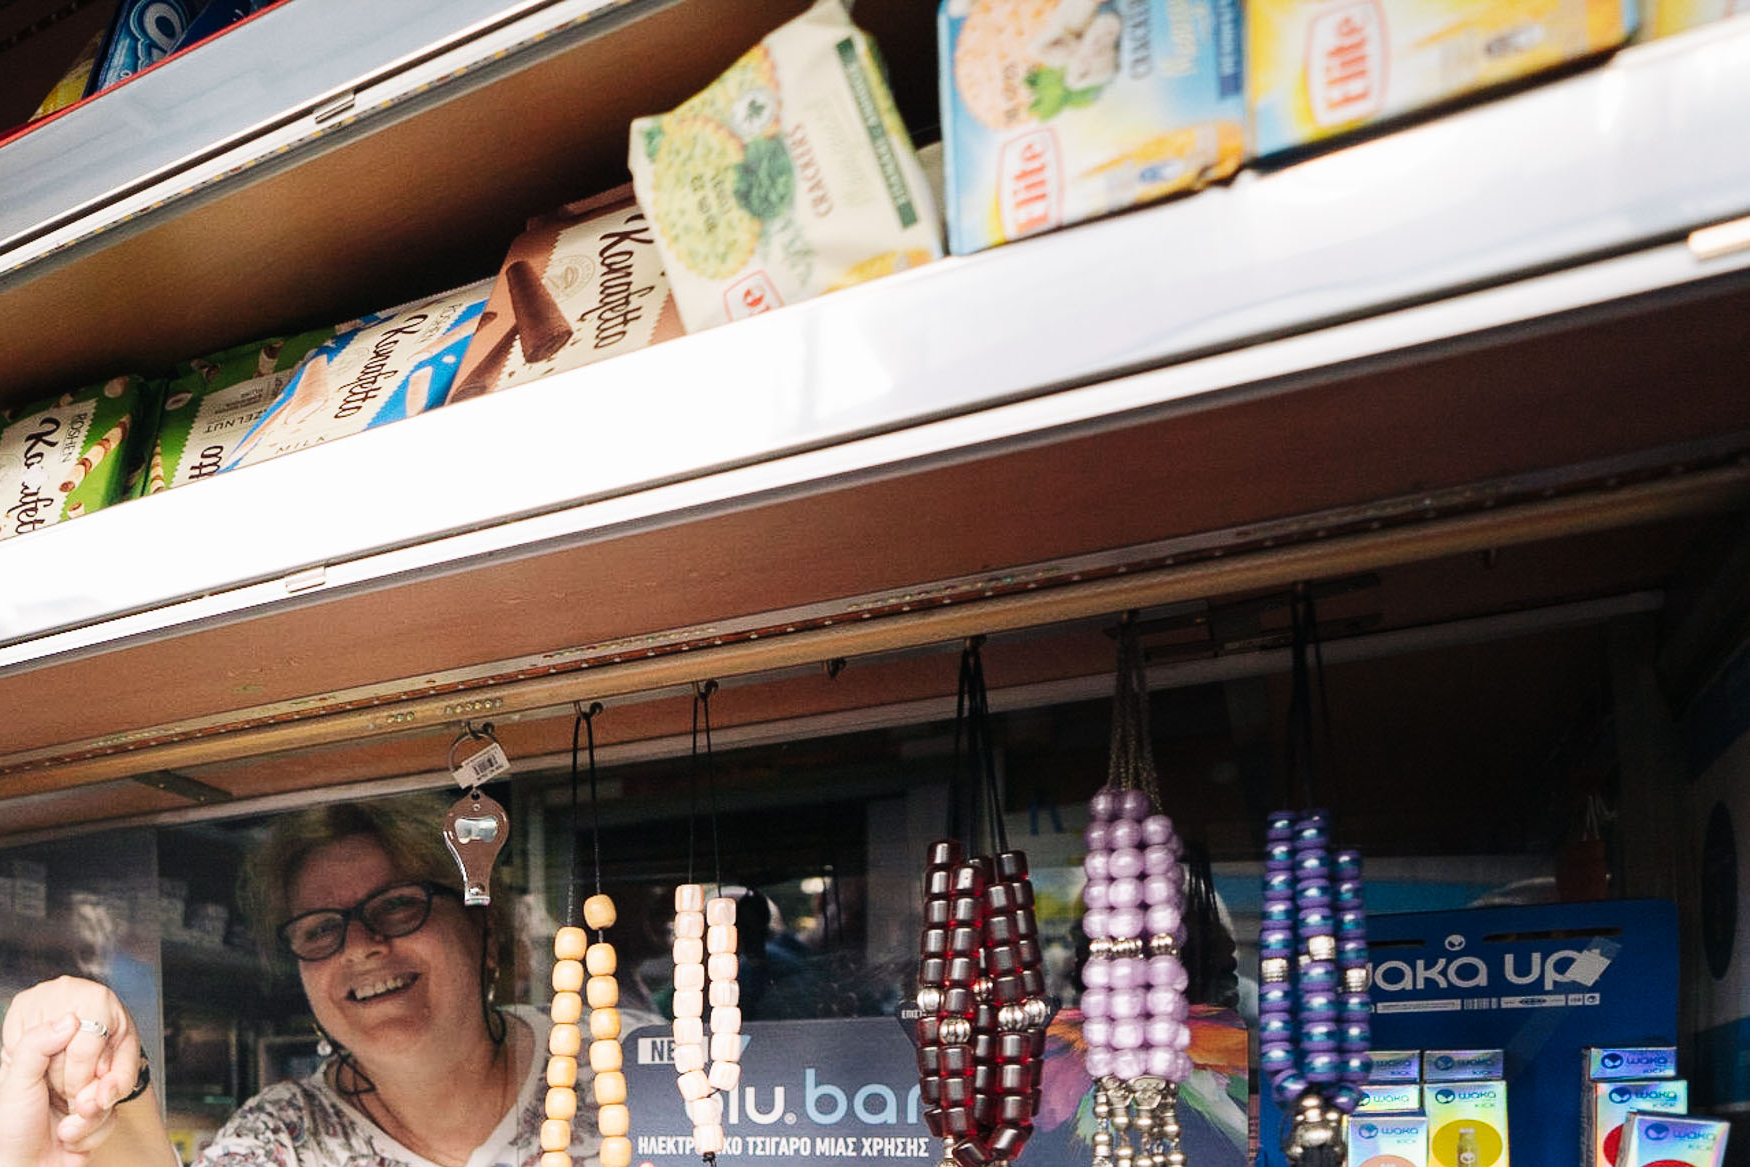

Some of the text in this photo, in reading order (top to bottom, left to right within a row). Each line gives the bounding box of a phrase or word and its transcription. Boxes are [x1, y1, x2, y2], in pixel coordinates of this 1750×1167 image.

[334, 314, 428, 419] Konafetto
[204, 408, 267, 434] ZELNUT
[1366, 957, 1488, 992] aka
[748, 1137, 811, 1157] ΤΣΙΓΑΡΟ
[815, 1138, 857, 1157] ΜΙΑΣ
[861, 1138, 929, 1158] ΧΡΗΣΗΣ
